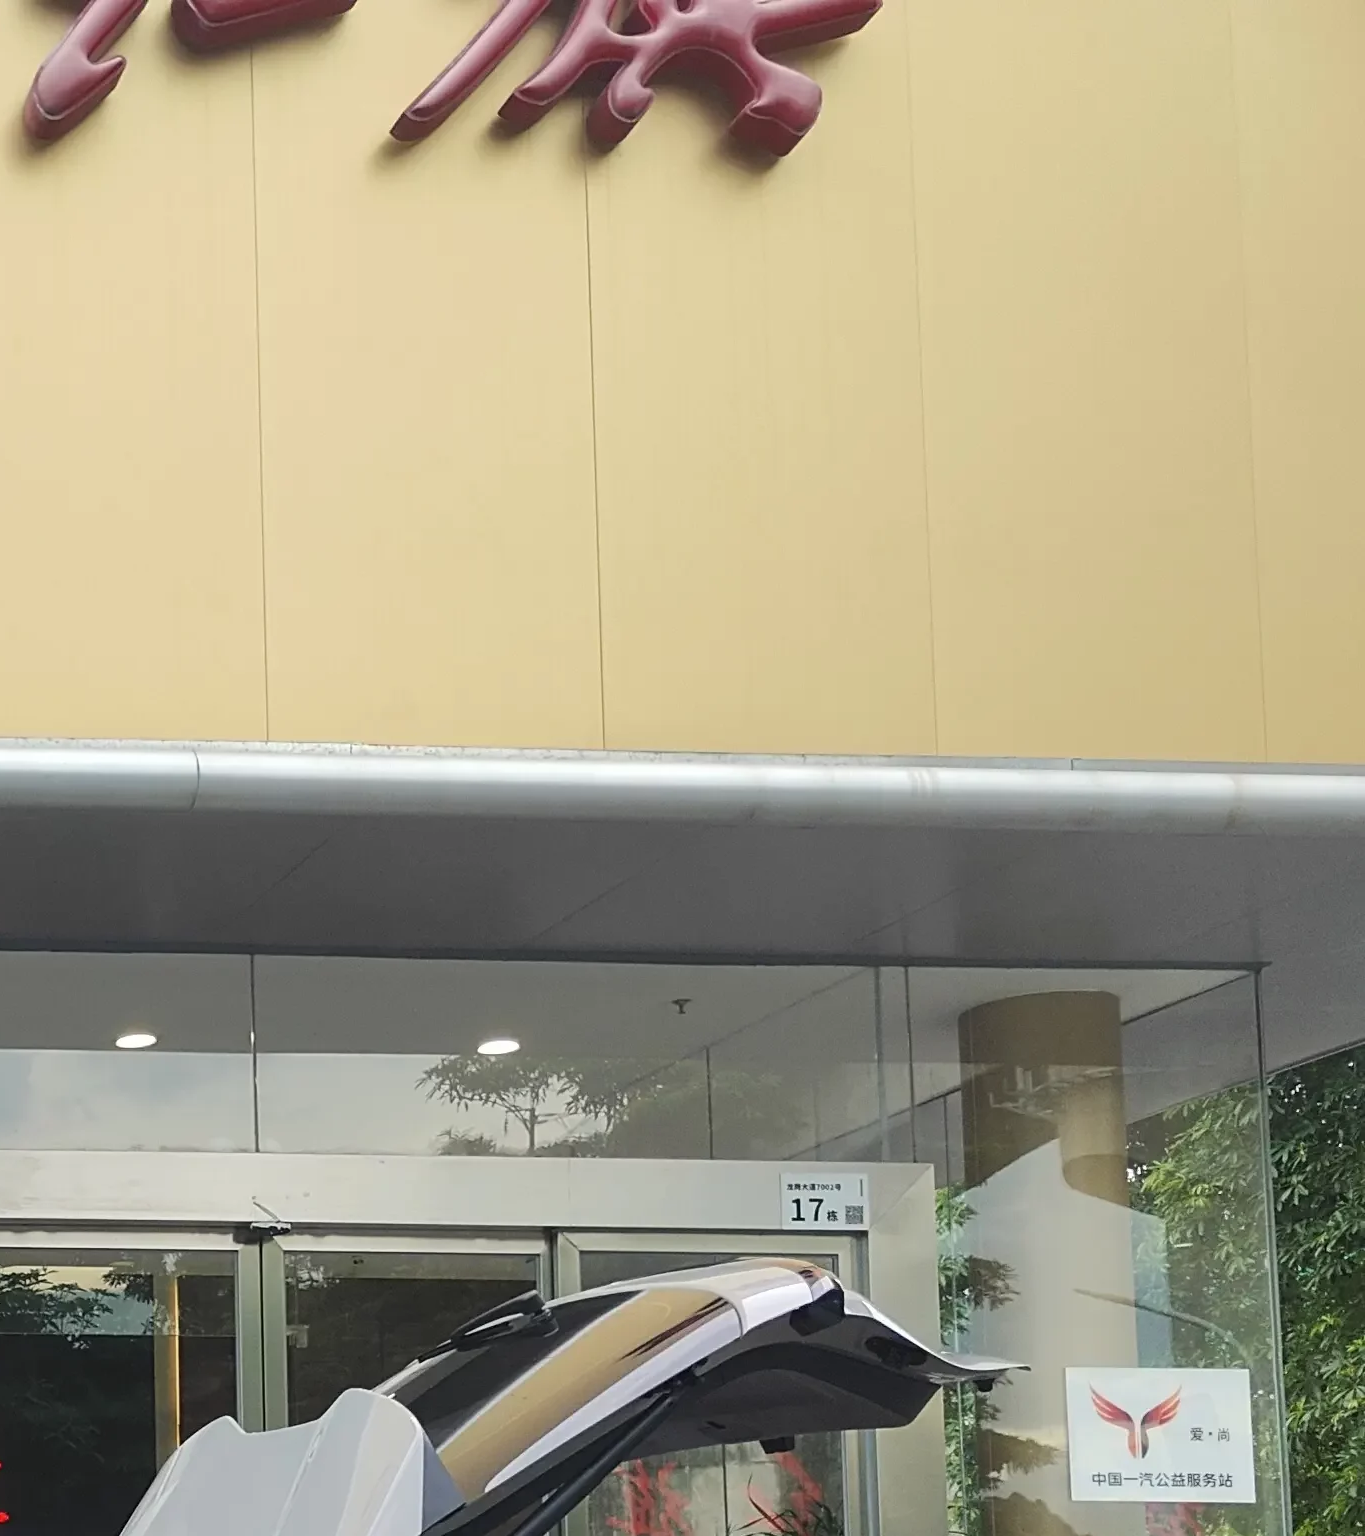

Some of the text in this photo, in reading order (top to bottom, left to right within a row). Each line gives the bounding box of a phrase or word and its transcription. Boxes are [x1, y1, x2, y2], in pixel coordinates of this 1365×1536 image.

[791, 1198, 839, 1222] 17栋
[1091, 1472, 1234, 1488] 中国一汽公益服务站
